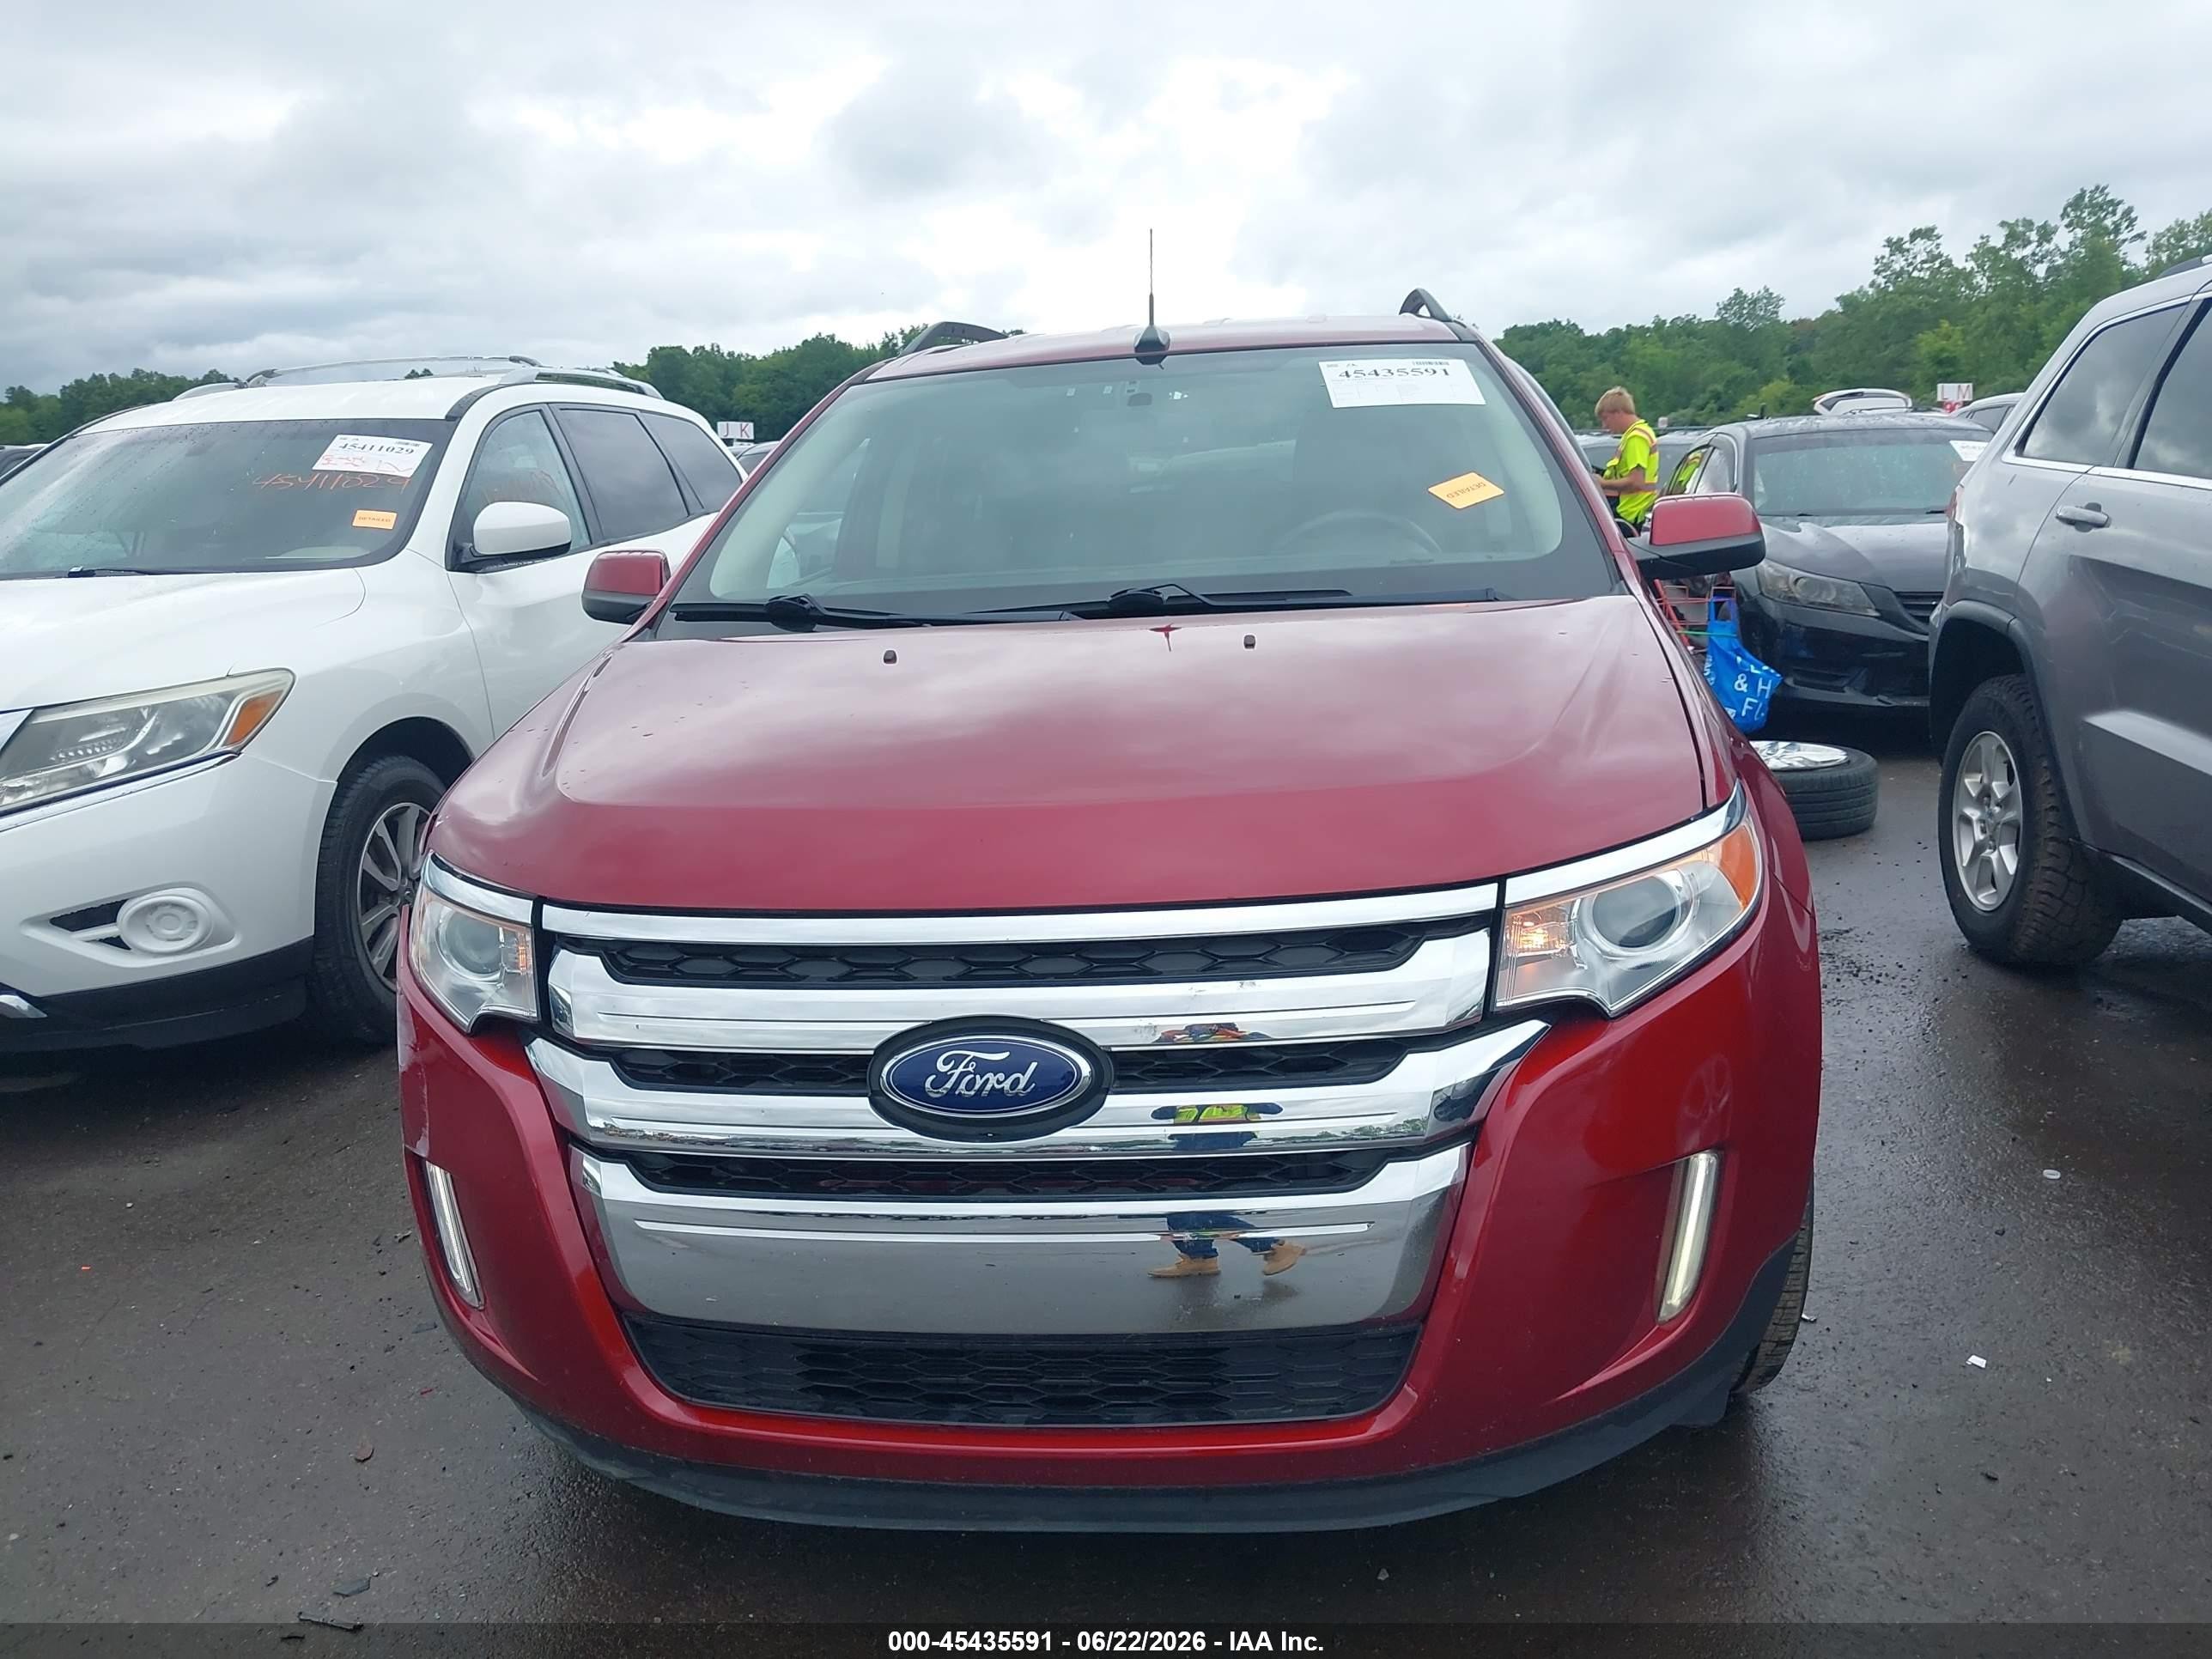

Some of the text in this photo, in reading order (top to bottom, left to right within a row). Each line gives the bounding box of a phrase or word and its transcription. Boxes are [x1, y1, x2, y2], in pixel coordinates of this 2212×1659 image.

[1339, 368, 1450, 379] 45435591
[1942, 384, 1972, 400] L M
[723, 422, 750, 438] J K
[338, 442, 415, 455] 45411029
[252, 472, 411, 495] 45411029
[1446, 482, 1487, 499] DETAILED
[1734, 673, 1748, 693] &
[925, 1050, 1038, 1098] Ford
